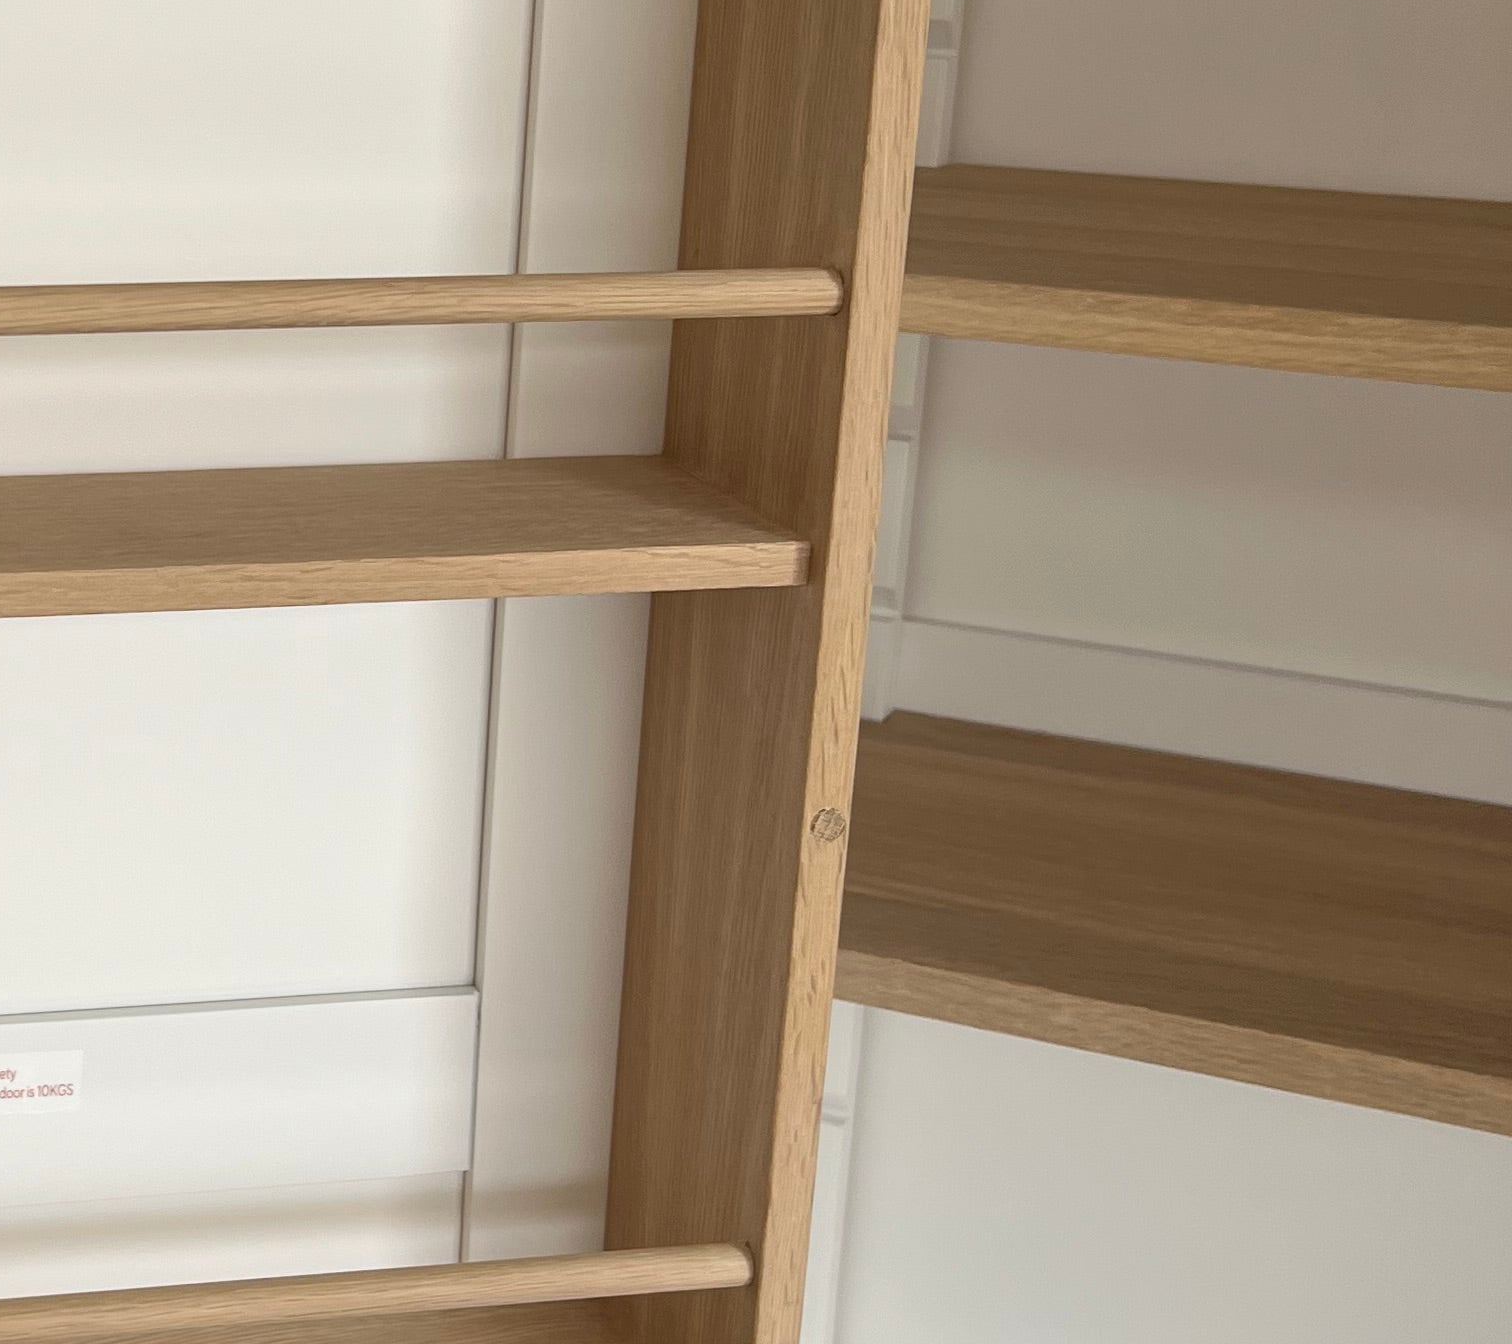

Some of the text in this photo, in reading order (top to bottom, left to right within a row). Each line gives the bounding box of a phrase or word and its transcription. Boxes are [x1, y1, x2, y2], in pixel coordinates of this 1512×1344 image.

[0, 1086, 24, 1099] door
[26, 1086, 35, 1098] is
[37, 1083, 74, 1097] 10KGS
